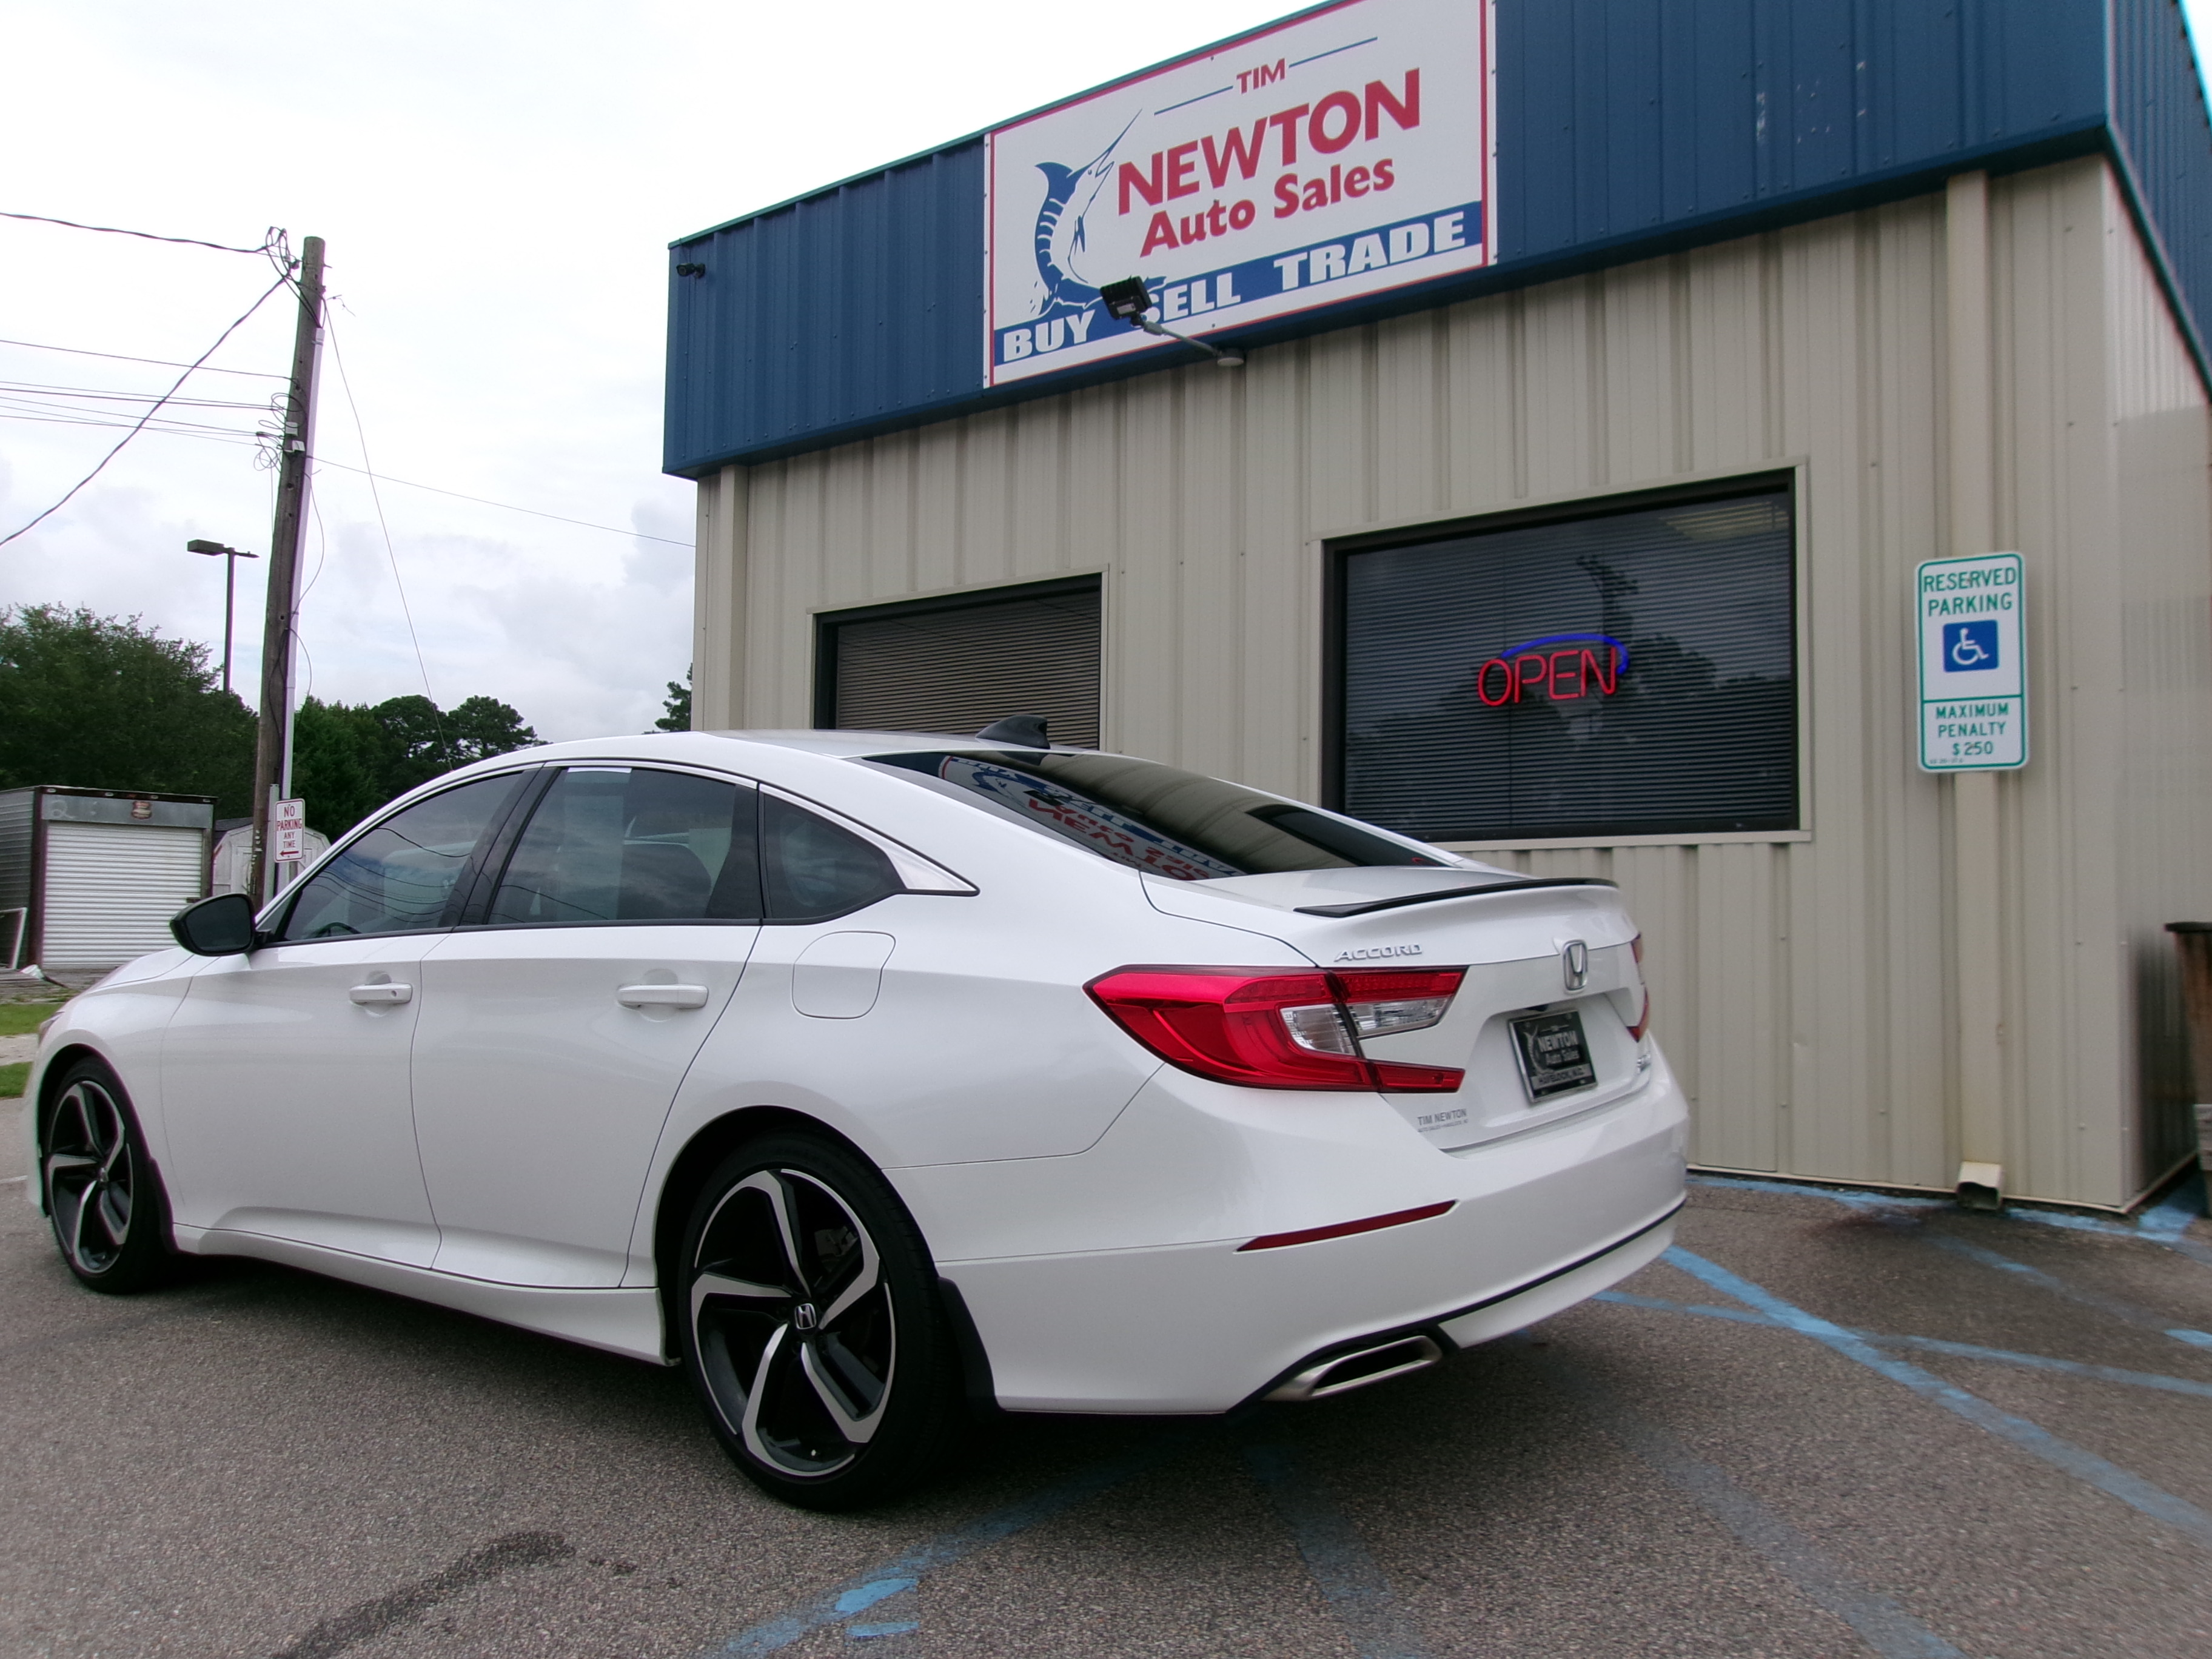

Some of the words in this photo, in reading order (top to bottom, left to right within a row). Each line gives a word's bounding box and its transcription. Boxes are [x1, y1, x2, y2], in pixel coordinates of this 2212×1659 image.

[1236, 58, 1285, 94] TIM
[1119, 67, 1419, 215] NEWTON
[1140, 199, 1255, 258] Auto
[1274, 158, 1395, 218] Sales
[1004, 310, 1095, 362] BUY
[1273, 212, 1466, 291] TRADE
[1923, 567, 2016, 592] RESERVED
[1928, 592, 2013, 617] PARKING
[1477, 646, 1617, 706] OPEN
[1936, 702, 2009, 719] MAXIMUM
[1938, 721, 2006, 738] PENALTY
[1952, 740, 1994, 756] $250
[284, 806, 295, 817] NO
[276, 819, 302, 831] PARKING
[284, 831, 295, 840] ANY
[1333, 943, 1423, 962] ACCORD
[1538, 1031, 1578, 1052] NEWTON
[1418, 1115, 1432, 1125] TIM
[1434, 1108, 1467, 1123] NEWTON
